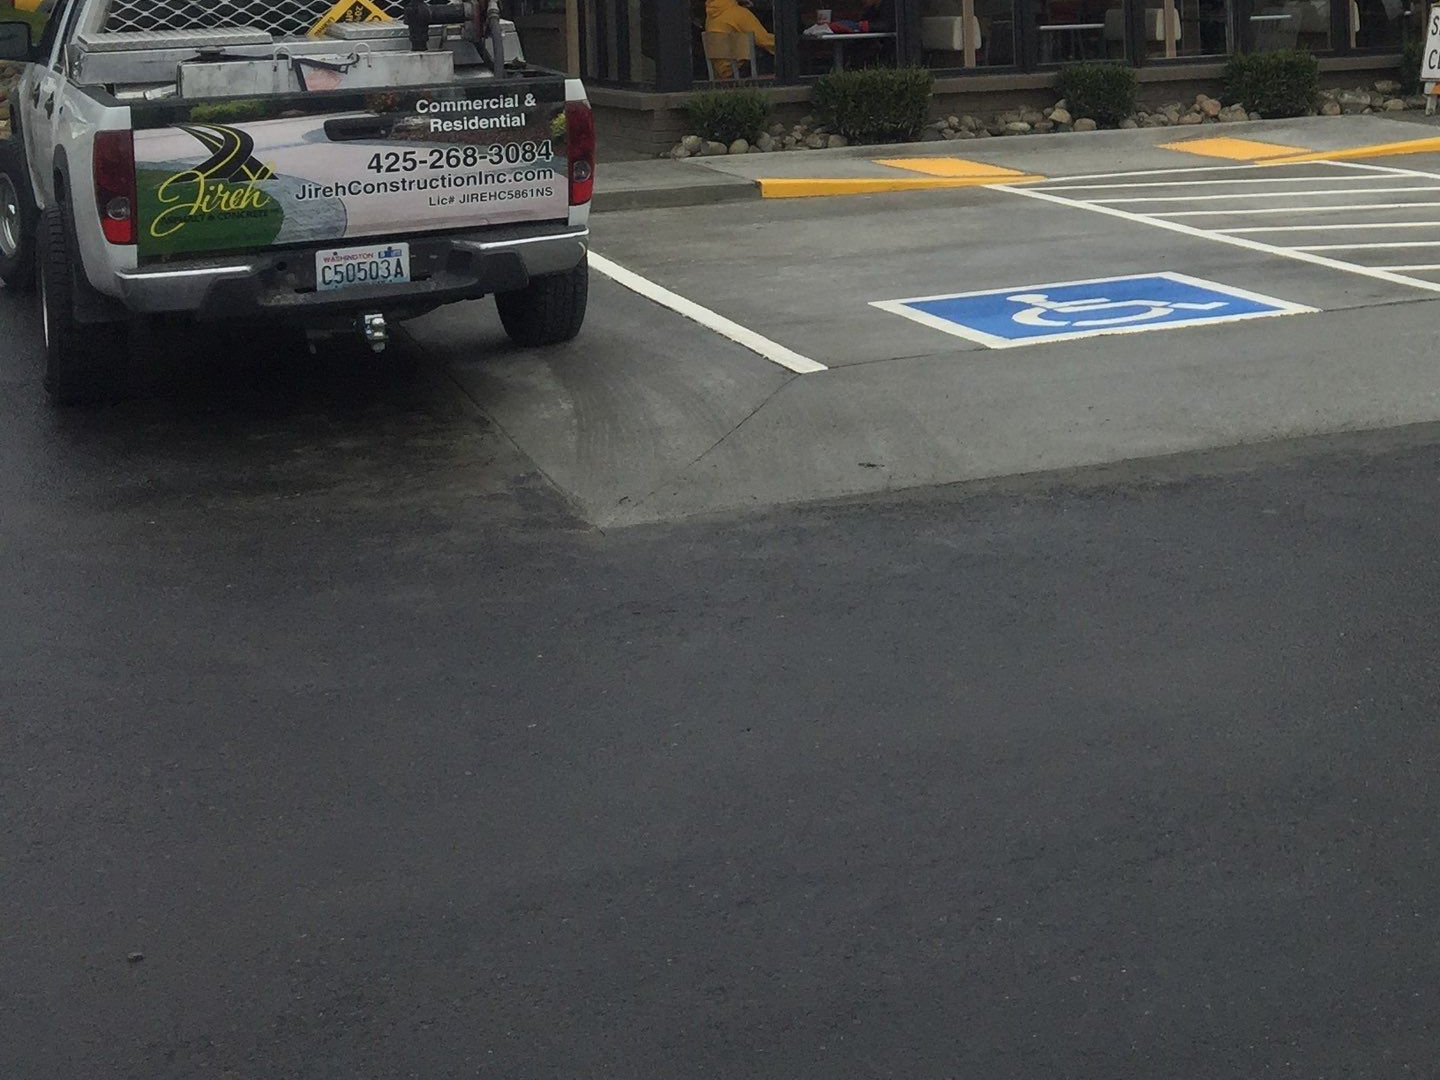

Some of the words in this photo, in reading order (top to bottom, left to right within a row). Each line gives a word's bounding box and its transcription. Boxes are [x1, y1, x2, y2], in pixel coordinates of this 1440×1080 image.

[415, 94, 519, 115] Commercial
[524, 93, 537, 107] &
[429, 113, 526, 133] Residential
[367, 140, 553, 174] 425-268-3084
[295, 167, 554, 201] JirehConstructionInc.com
[151, 163, 274, 237] Jireh
[429, 195, 456, 207] Lic#
[322, 252, 374, 263] WASHINGTON
[321, 258, 405, 286] C50503A
